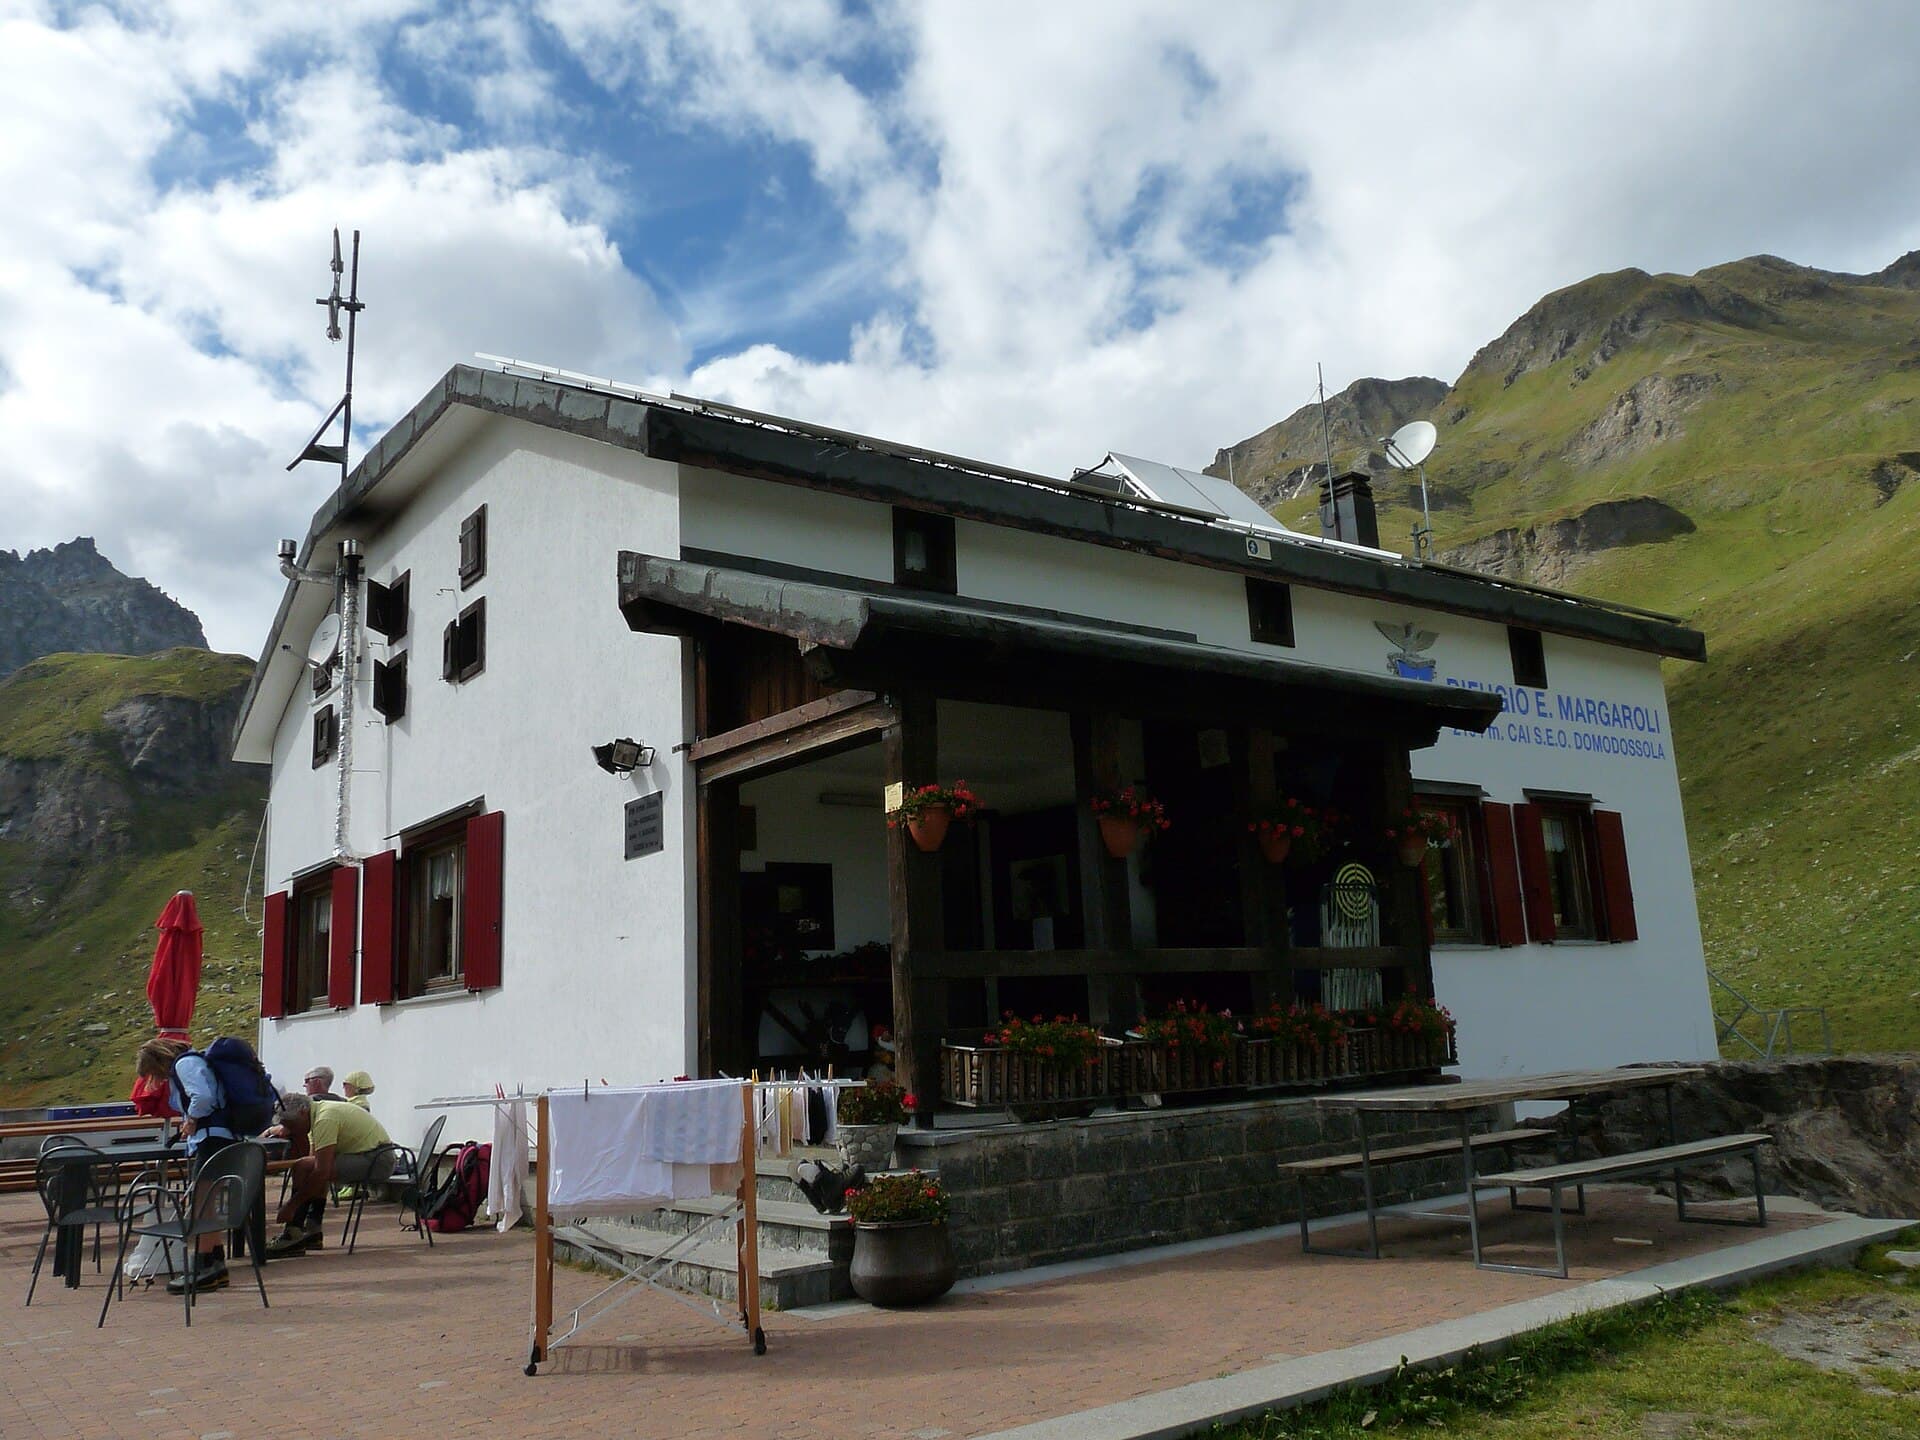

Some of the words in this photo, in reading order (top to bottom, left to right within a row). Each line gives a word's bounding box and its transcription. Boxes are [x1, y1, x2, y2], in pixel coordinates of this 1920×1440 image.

[1535, 691, 1553, 719] E.
[1557, 694, 1661, 734] MARGAROLI
[1508, 723, 1531, 744] CAI
[1534, 726, 1571, 749] S.E.O.
[1574, 732, 1666, 760] DOMODOSSOLA
